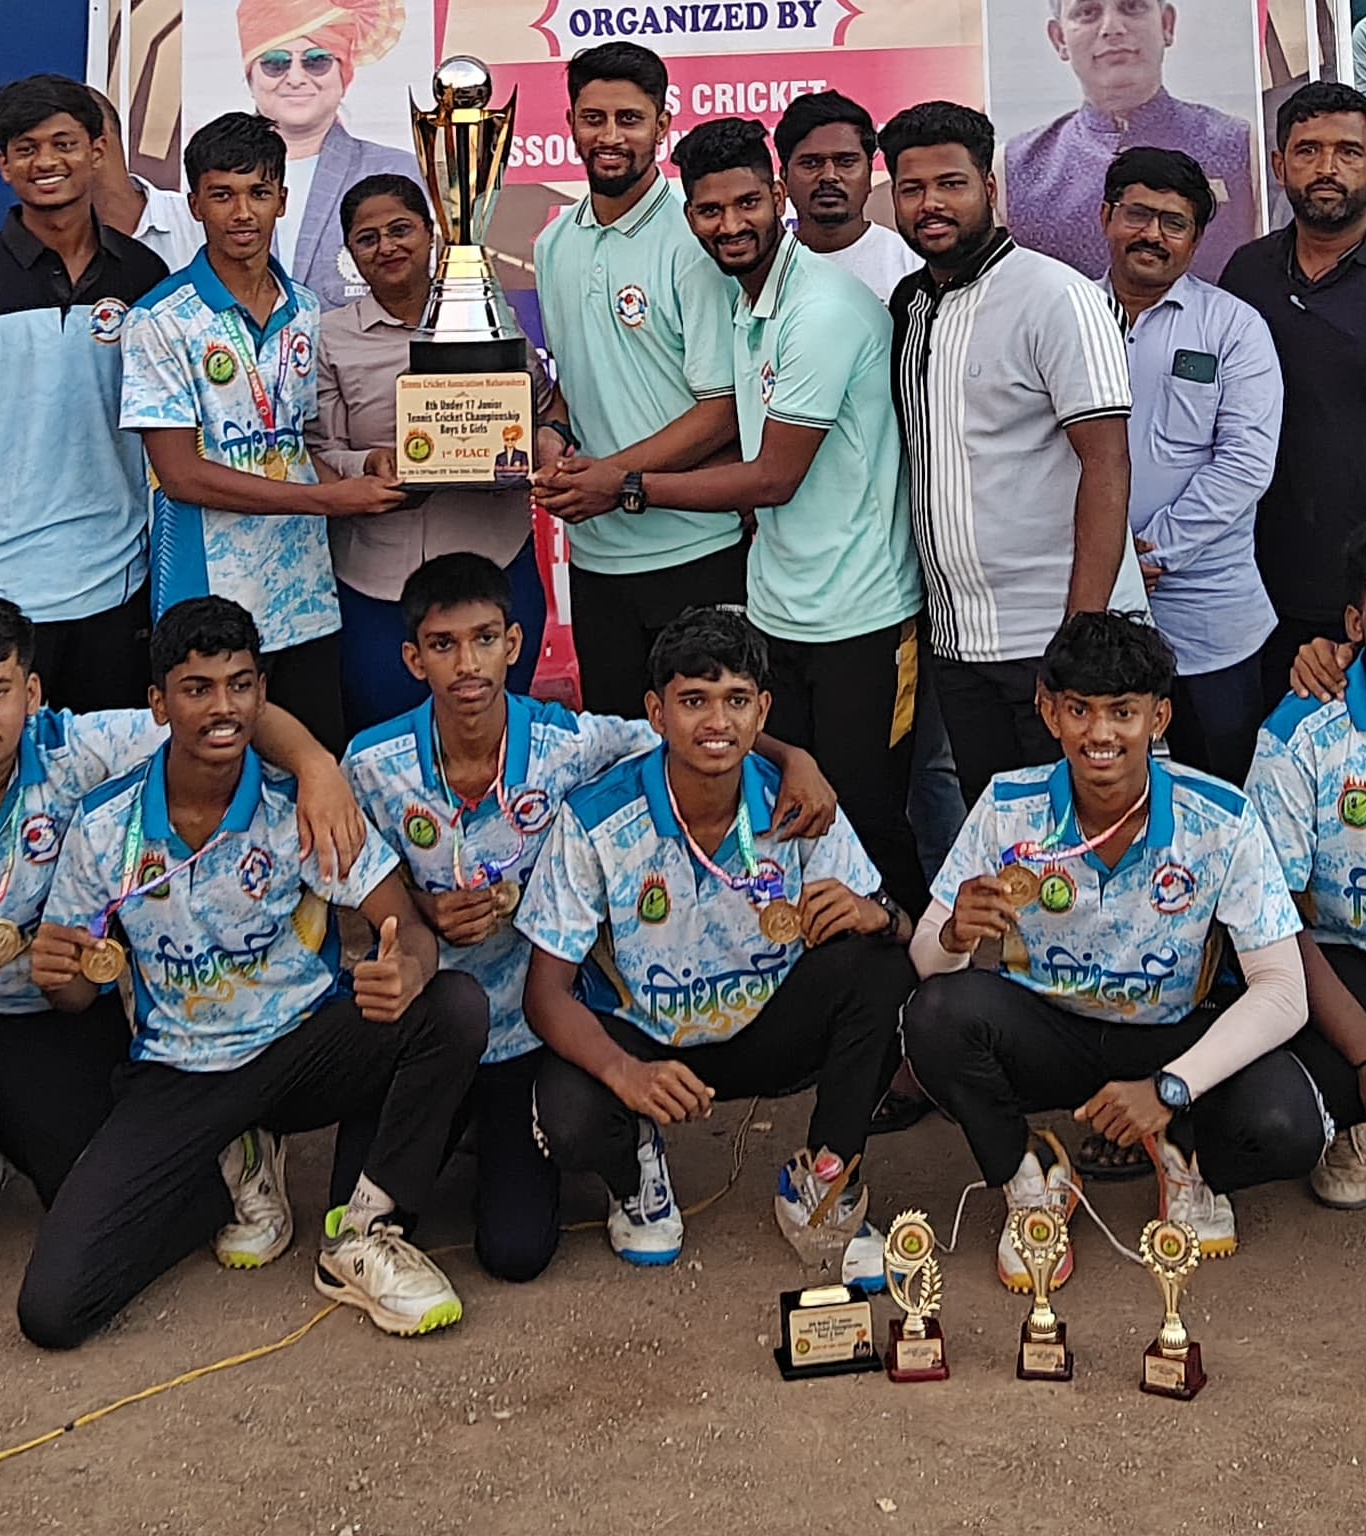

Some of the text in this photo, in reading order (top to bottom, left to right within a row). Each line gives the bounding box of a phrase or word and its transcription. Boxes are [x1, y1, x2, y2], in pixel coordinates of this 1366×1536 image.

[569, 0, 823, 37] ORGANIZED BY
[440, 400, 463, 410] Under
[466, 400, 475, 409] 17
[477, 398, 502, 409] Junior
[407, 410, 520, 423] Tennis Cricket Championship
[440, 424, 459, 436] Boys
[469, 423, 488, 434] Girls
[455, 448, 491, 458] PLACE
